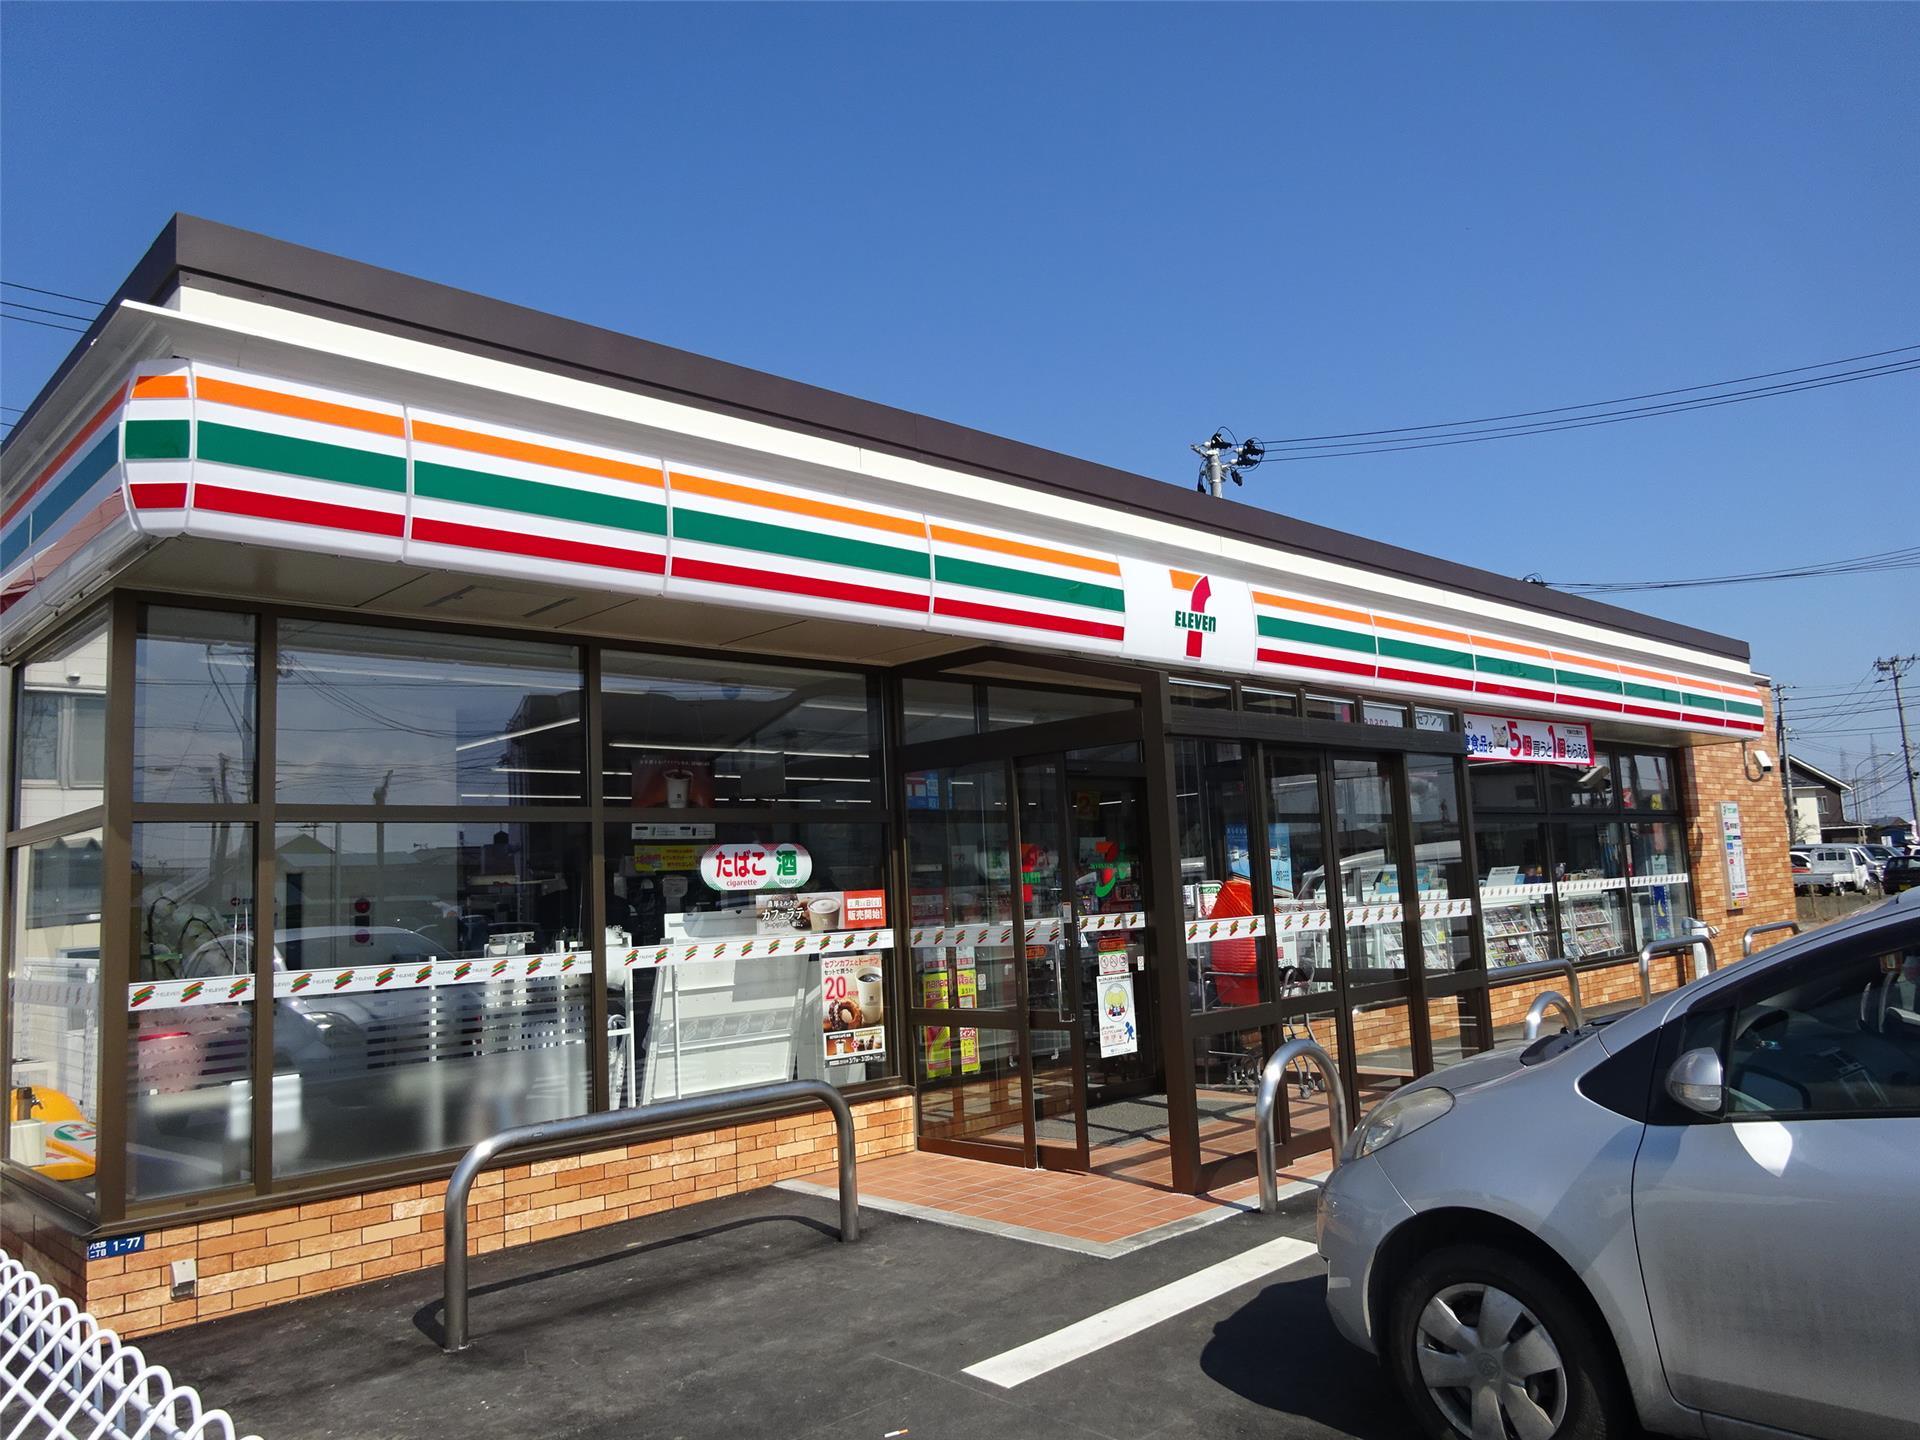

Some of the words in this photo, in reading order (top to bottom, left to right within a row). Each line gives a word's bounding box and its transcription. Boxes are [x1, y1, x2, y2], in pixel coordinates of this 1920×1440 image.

[715, 850, 767, 877] たばこ
[776, 850, 797, 876] 酒
[726, 879, 758, 887] cigarette
[761, 907, 805, 921] カフェラテ
[825, 976, 847, 1000] 20
[113, 1236, 141, 1251] 1-77
